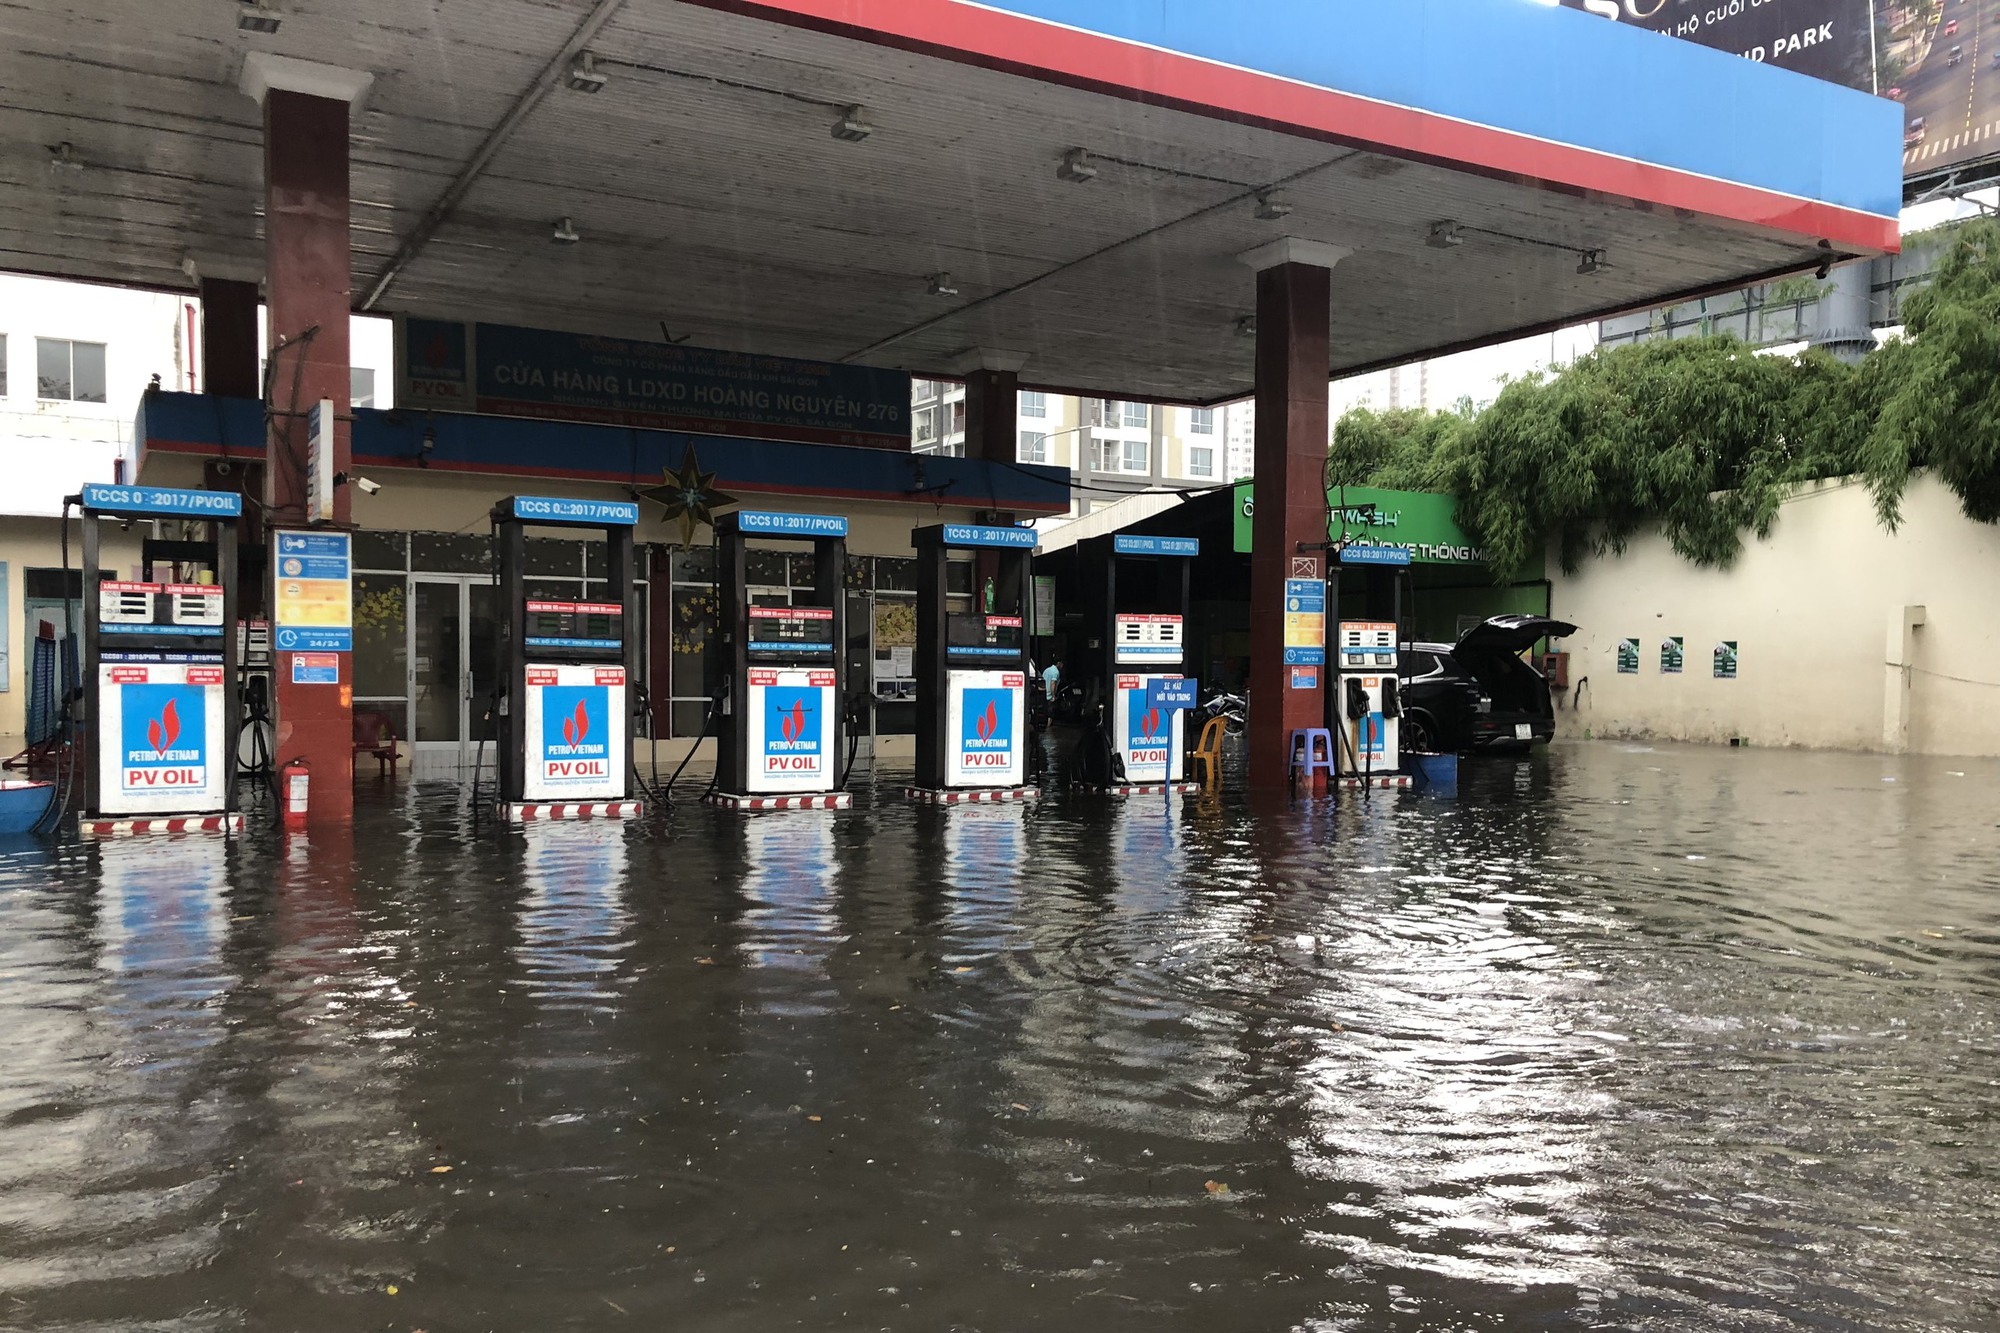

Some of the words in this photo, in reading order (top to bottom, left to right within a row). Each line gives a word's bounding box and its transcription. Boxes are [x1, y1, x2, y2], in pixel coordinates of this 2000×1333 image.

[1677, 15, 1699, 36] HỘ
[1773, 21, 1833, 58] PARK
[495, 360, 546, 387] CỬA
[552, 368, 620, 394] HÀNG
[627, 378, 687, 401] LDXD
[694, 383, 770, 409] HOÀNG
[777, 393, 861, 418] NGUYÊN
[867, 403, 898, 421] 276
[90, 488, 129, 503] TCCS
[520, 500, 551, 513] TCCS
[744, 515, 770, 526] TCCS
[773, 516, 843, 531] 01:2017/PVOIL
[948, 528, 970, 539] TCCS
[1343, 549, 1361, 558] TCCS
[1362, 550, 1408, 560] 03:2017/PVOIL
[1418, 541, 1469, 560] THÔNG
[769, 740, 816, 750] PETROVIETNAM
[965, 738, 1007, 747] PETROVIETNAM
[129, 749, 199, 762] PETROVIETNAM
[548, 744, 603, 755] PETROVIETNAM
[1132, 751, 1147, 762] PV
[1149, 750, 1167, 761] OIL
[769, 757, 789, 770] PV
[792, 756, 816, 769] OIL
[965, 754, 982, 766] PV
[985, 753, 1007, 765] OIL
[549, 763, 572, 776] PV
[575, 762, 603, 775] OIL
[129, 770, 159, 785] PV
[163, 769, 199, 784] OIL
